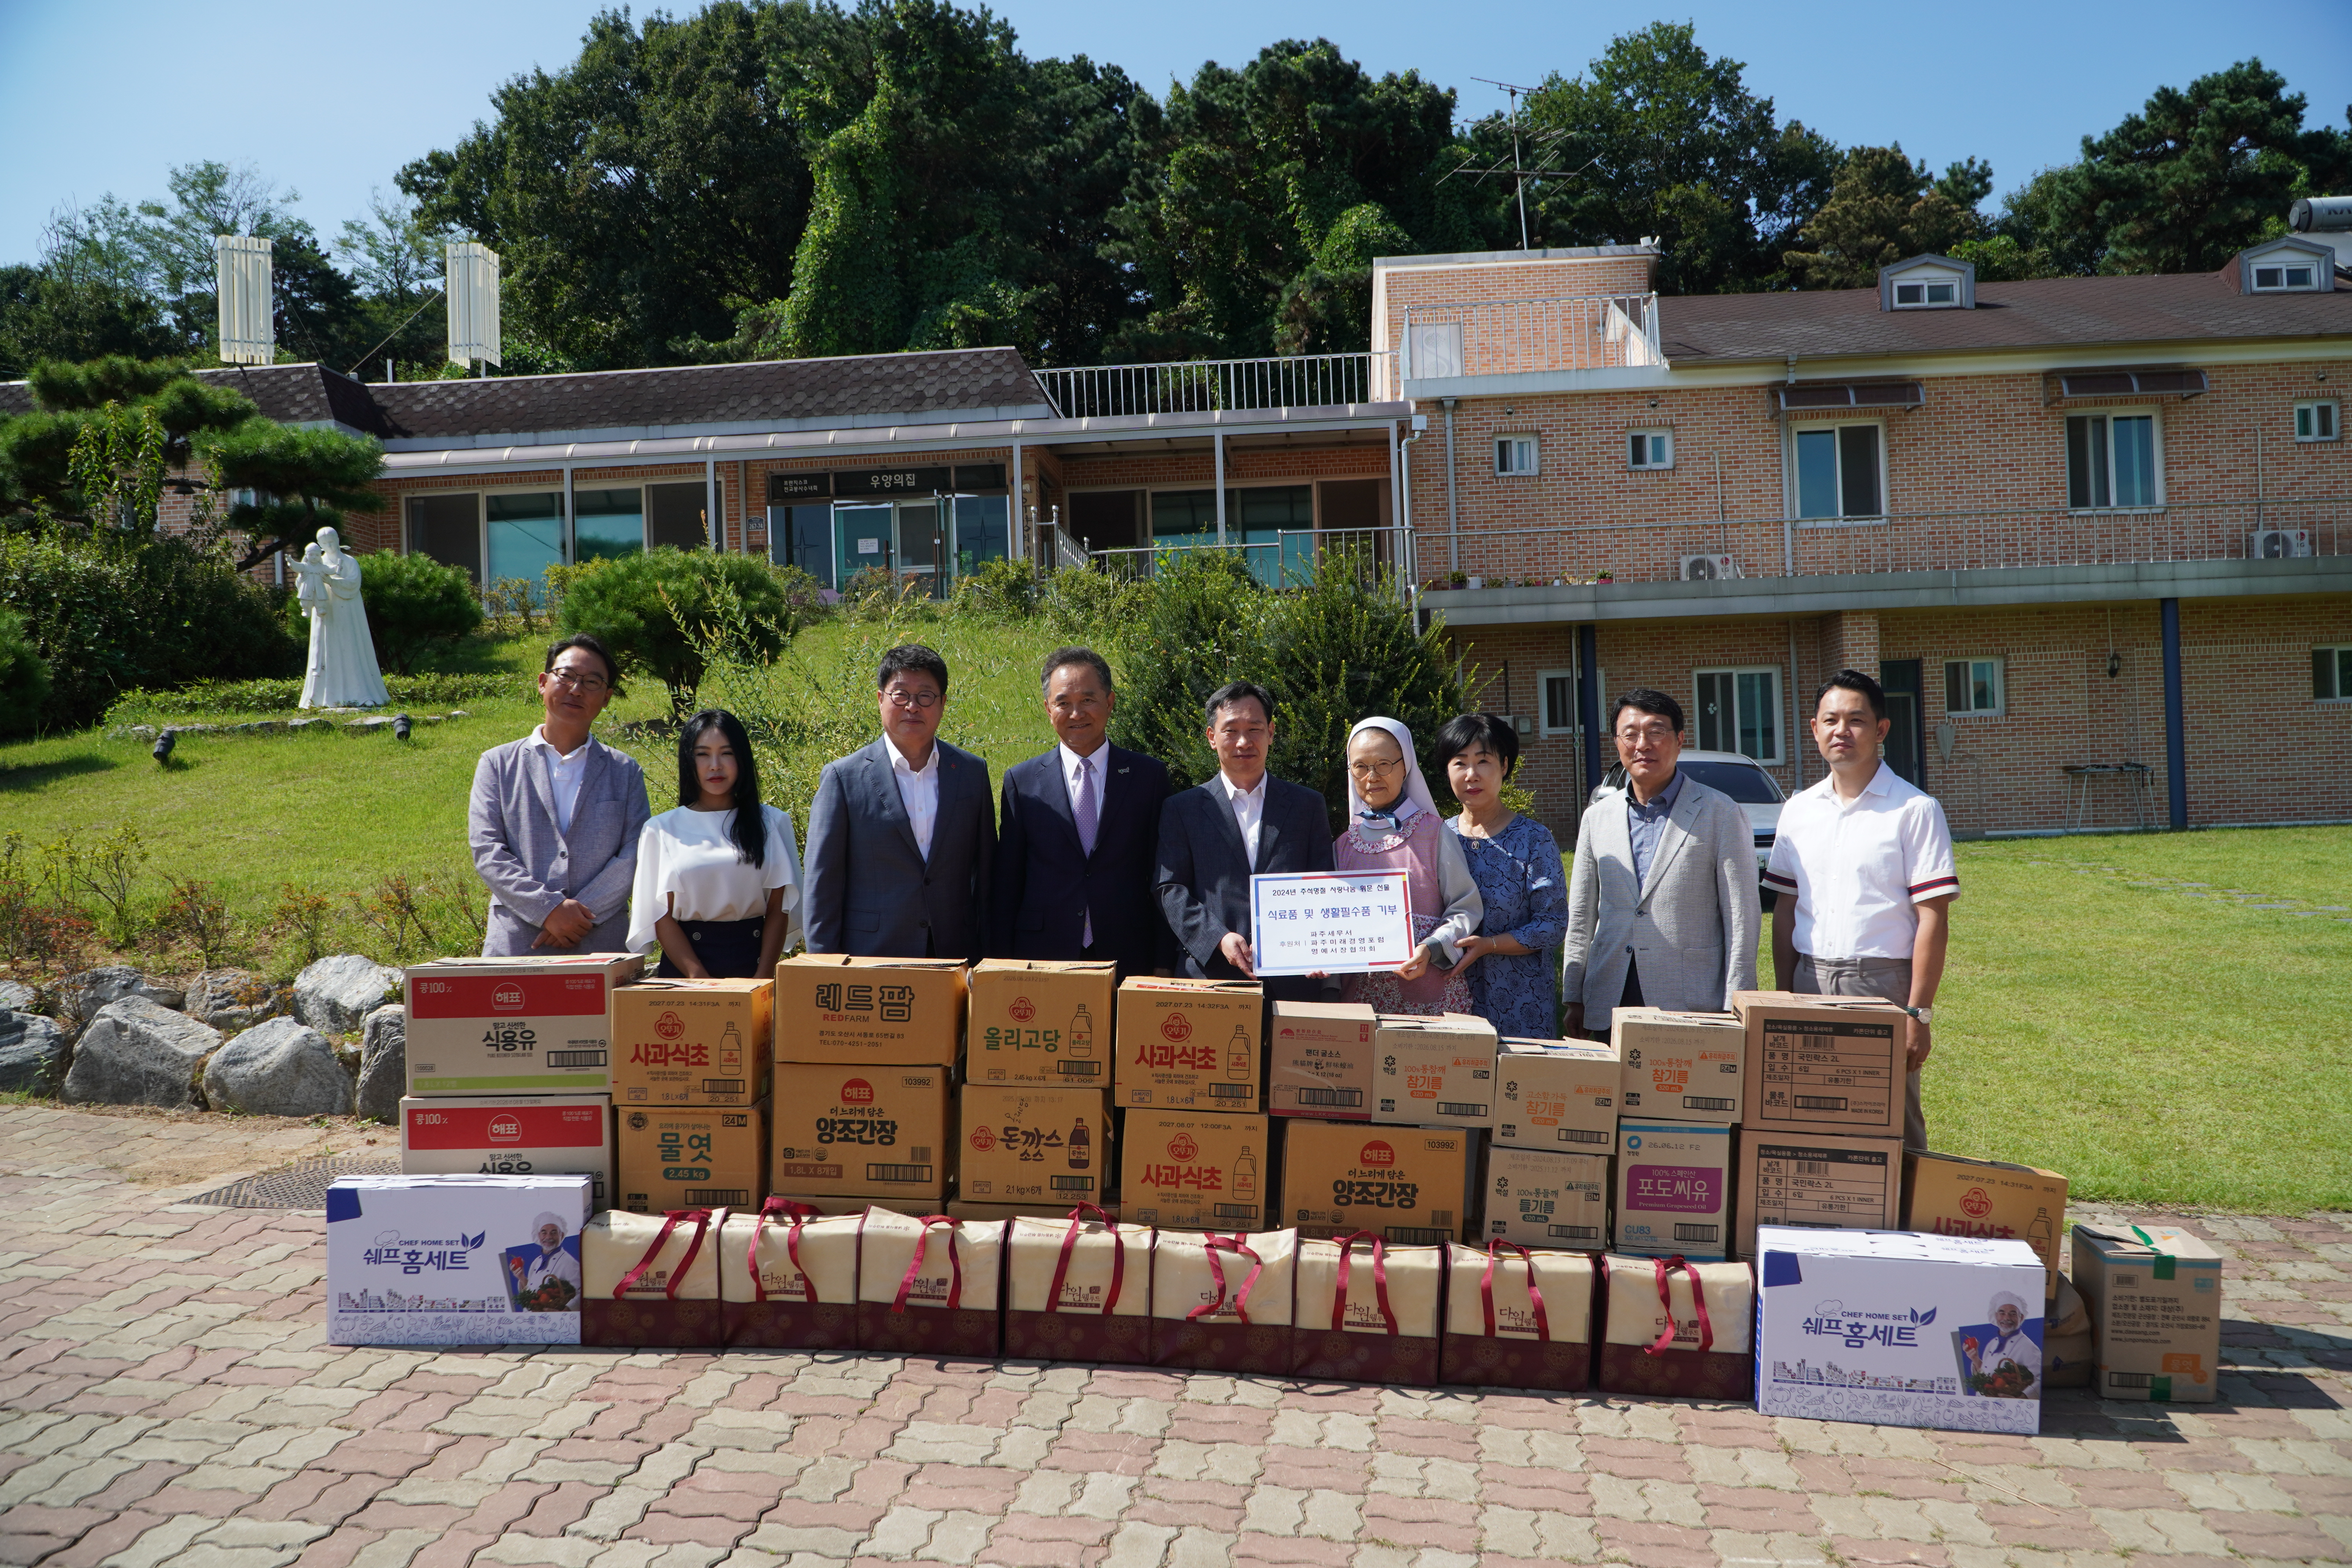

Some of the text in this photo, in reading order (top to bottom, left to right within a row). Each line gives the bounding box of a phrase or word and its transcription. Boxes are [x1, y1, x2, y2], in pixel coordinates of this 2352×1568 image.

[1268, 905, 1397, 920] 식료품 및 생활필수품 기부
[495, 991, 521, 1003] 해표
[823, 1014, 869, 1022] REDFARM
[482, 1030, 537, 1051] 식용유
[984, 1027, 1061, 1053] 올리고당
[630, 1043, 710, 1067] 사과식초
[1135, 1045, 1217, 1070] 사과식초
[1628, 1060, 1641, 1069] 백설
[1383, 1067, 1396, 1075] 백설
[1652, 1069, 1688, 1083] 참기름
[1407, 1075, 1442, 1089] 참기름
[844, 1087, 870, 1099] 해표
[1505, 1092, 1518, 1101] 백설
[1526, 1092, 1567, 1101] 고소함 가득
[830, 1106, 884, 1117] 더 느리게 담은
[1526, 1101, 1565, 1116] 참기름
[492, 1123, 517, 1135] 해표
[817, 1118, 898, 1146] 양조간장
[1000, 1127, 1064, 1150] 돈까스
[1020, 1149, 1044, 1161] 소스
[1363, 1149, 1391, 1161] 해표
[693, 1169, 705, 1179] kg
[817, 1167, 837, 1175] 8개입
[1358, 1170, 1385, 1180] 느리게
[1387, 1170, 1405, 1180] 담은
[1671, 1170, 1695, 1178] 스페인산
[1956, 1174, 1995, 1184] 2027.07.23
[1333, 1180, 1418, 1209] 양조간장
[1637, 1179, 1709, 1201] 포도씨유
[1520, 1199, 1555, 1214] 들기름
[1965, 1201, 1986, 1212] 오뚜기
[1625, 1225, 1650, 1234] CU83
